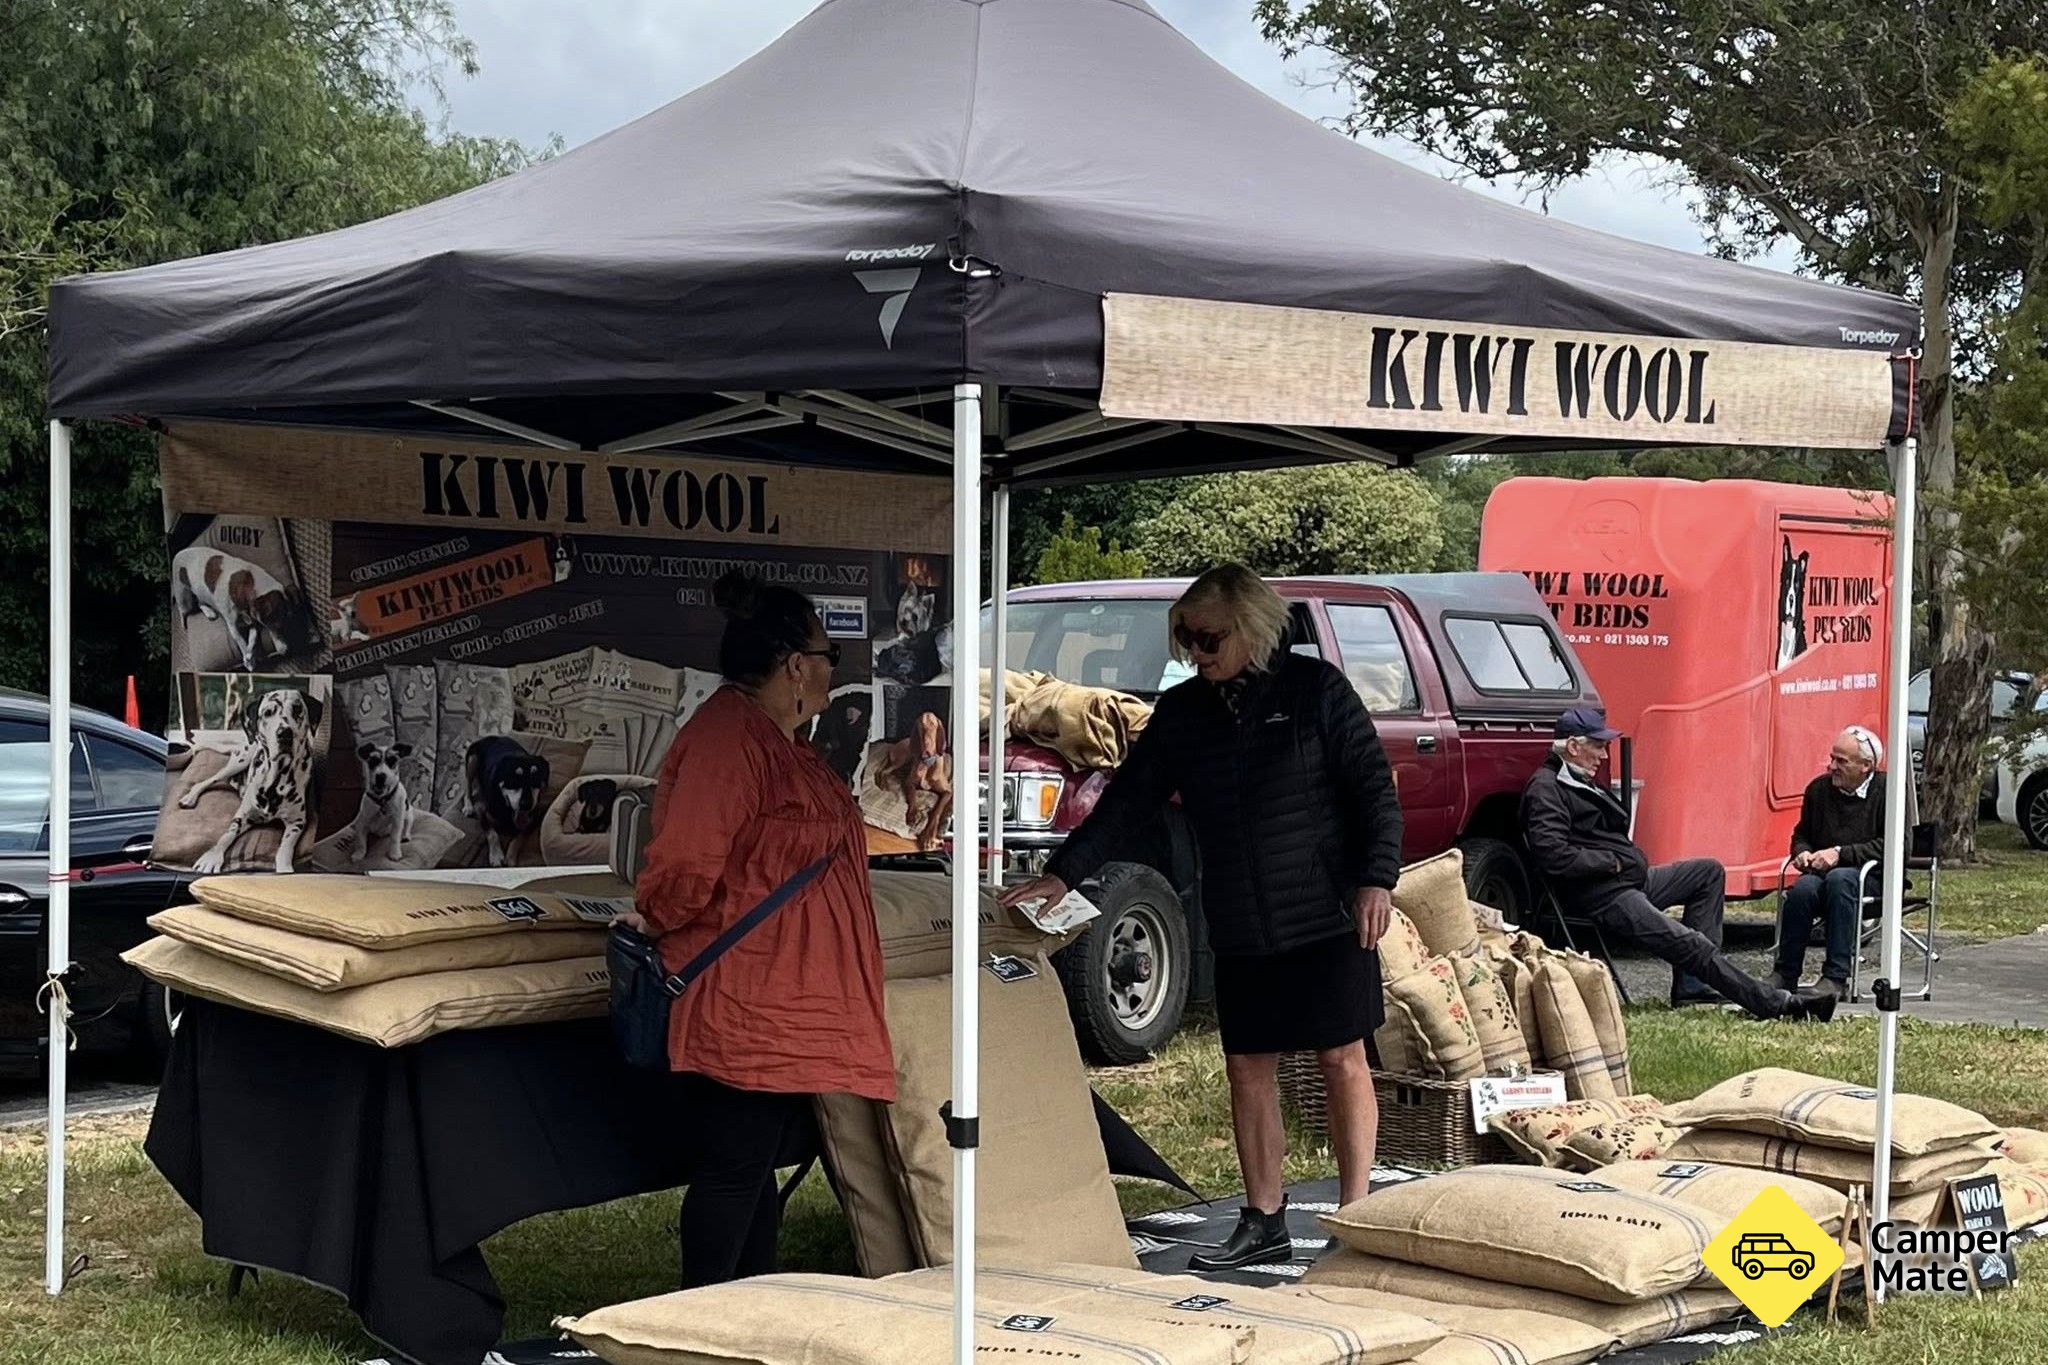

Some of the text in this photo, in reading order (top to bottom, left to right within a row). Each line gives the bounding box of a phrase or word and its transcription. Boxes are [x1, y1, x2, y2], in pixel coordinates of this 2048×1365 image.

[845, 243, 936, 263] Torpedo7
[1838, 326, 1900, 347] Torpedo7
[1366, 326, 1716, 425] KIWI WOOL
[420, 452, 780, 534] KIWI WOOL
[220, 525, 265, 548] DIGBY
[350, 535, 470, 582] CUSTOM STENCILS
[376, 554, 532, 618] KIWIWOOL
[1583, 572, 1668, 598] WOOL
[1808, 576, 1879, 606] KIWI WOOL
[418, 586, 505, 620] PET BEDS
[1572, 602, 1649, 629] BEDS
[335, 649, 375, 672] MADE
[390, 632, 421, 654] NEW
[422, 614, 481, 645] ZEALAND
[450, 599, 605, 659] WOOL COTTON JUTE
[1604, 634, 1622, 645] 021
[1626, 634, 1649, 645] 1303
[1653, 635, 1669, 646] 175
[1812, 615, 1872, 643] PET BEDS
[1957, 1183, 2003, 1214] WOOL
